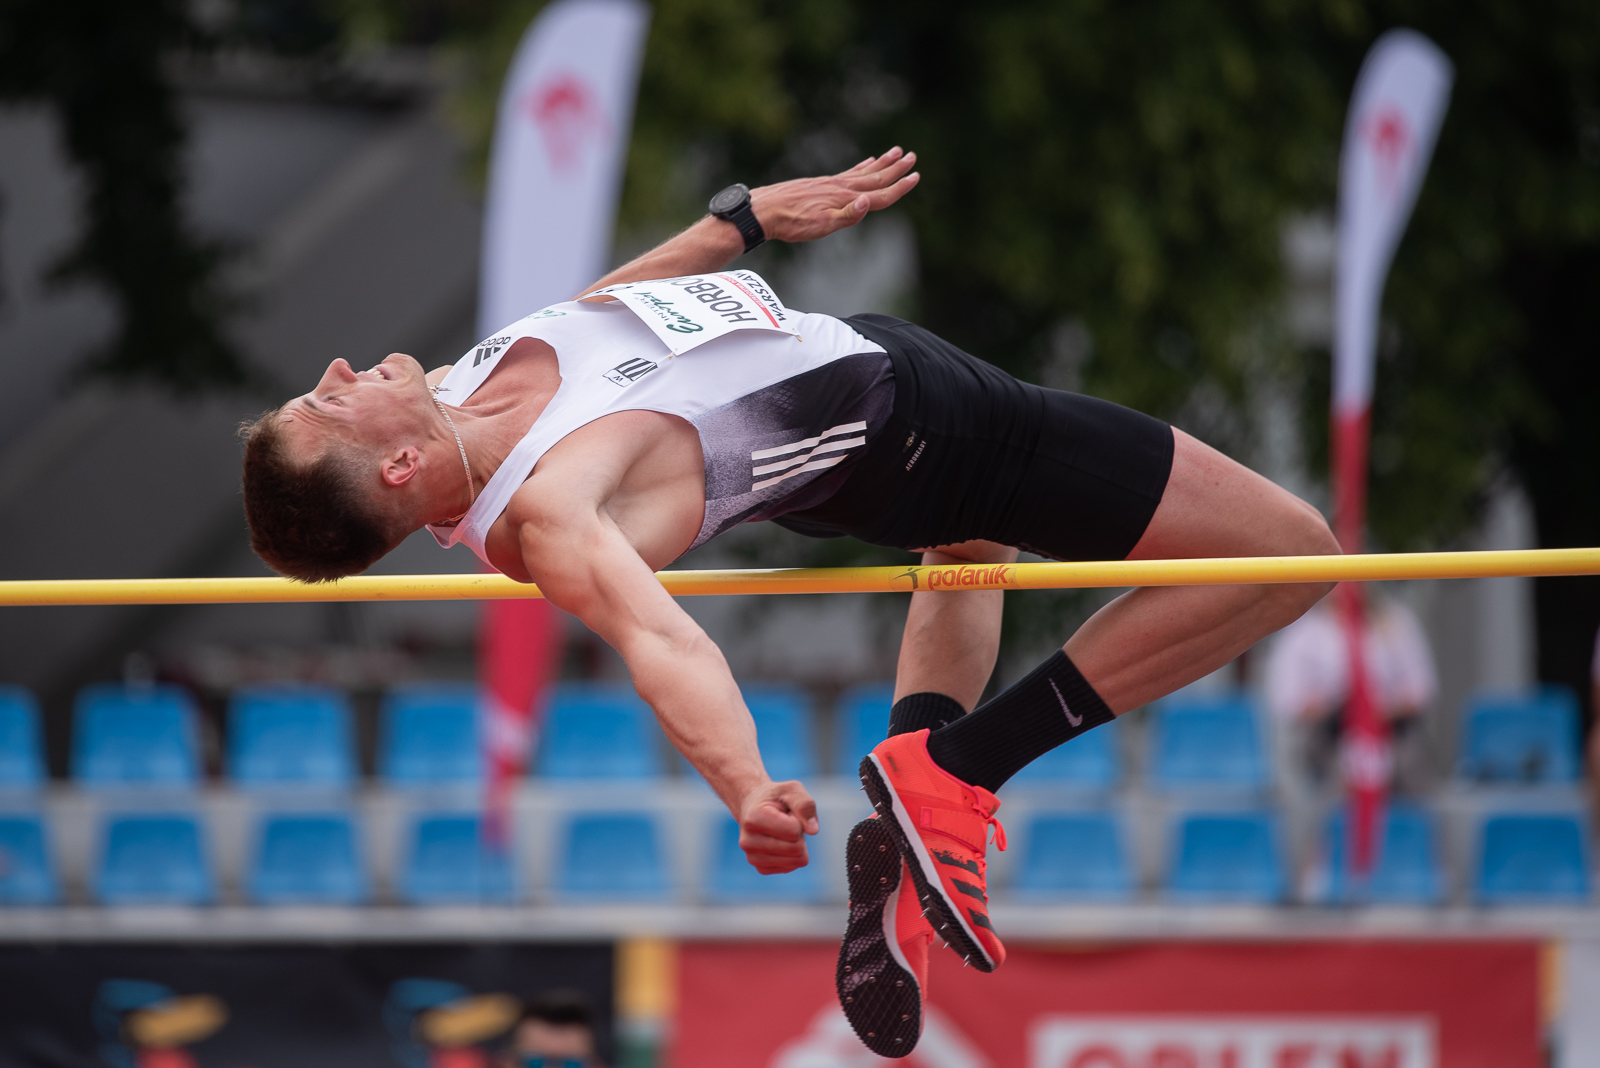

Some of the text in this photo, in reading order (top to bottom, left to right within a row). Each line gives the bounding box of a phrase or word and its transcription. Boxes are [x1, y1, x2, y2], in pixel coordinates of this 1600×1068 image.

[671, 277, 758, 323] HORBO
[905, 440, 927, 471] AEROREADY
[928, 565, 1010, 590] polanik
